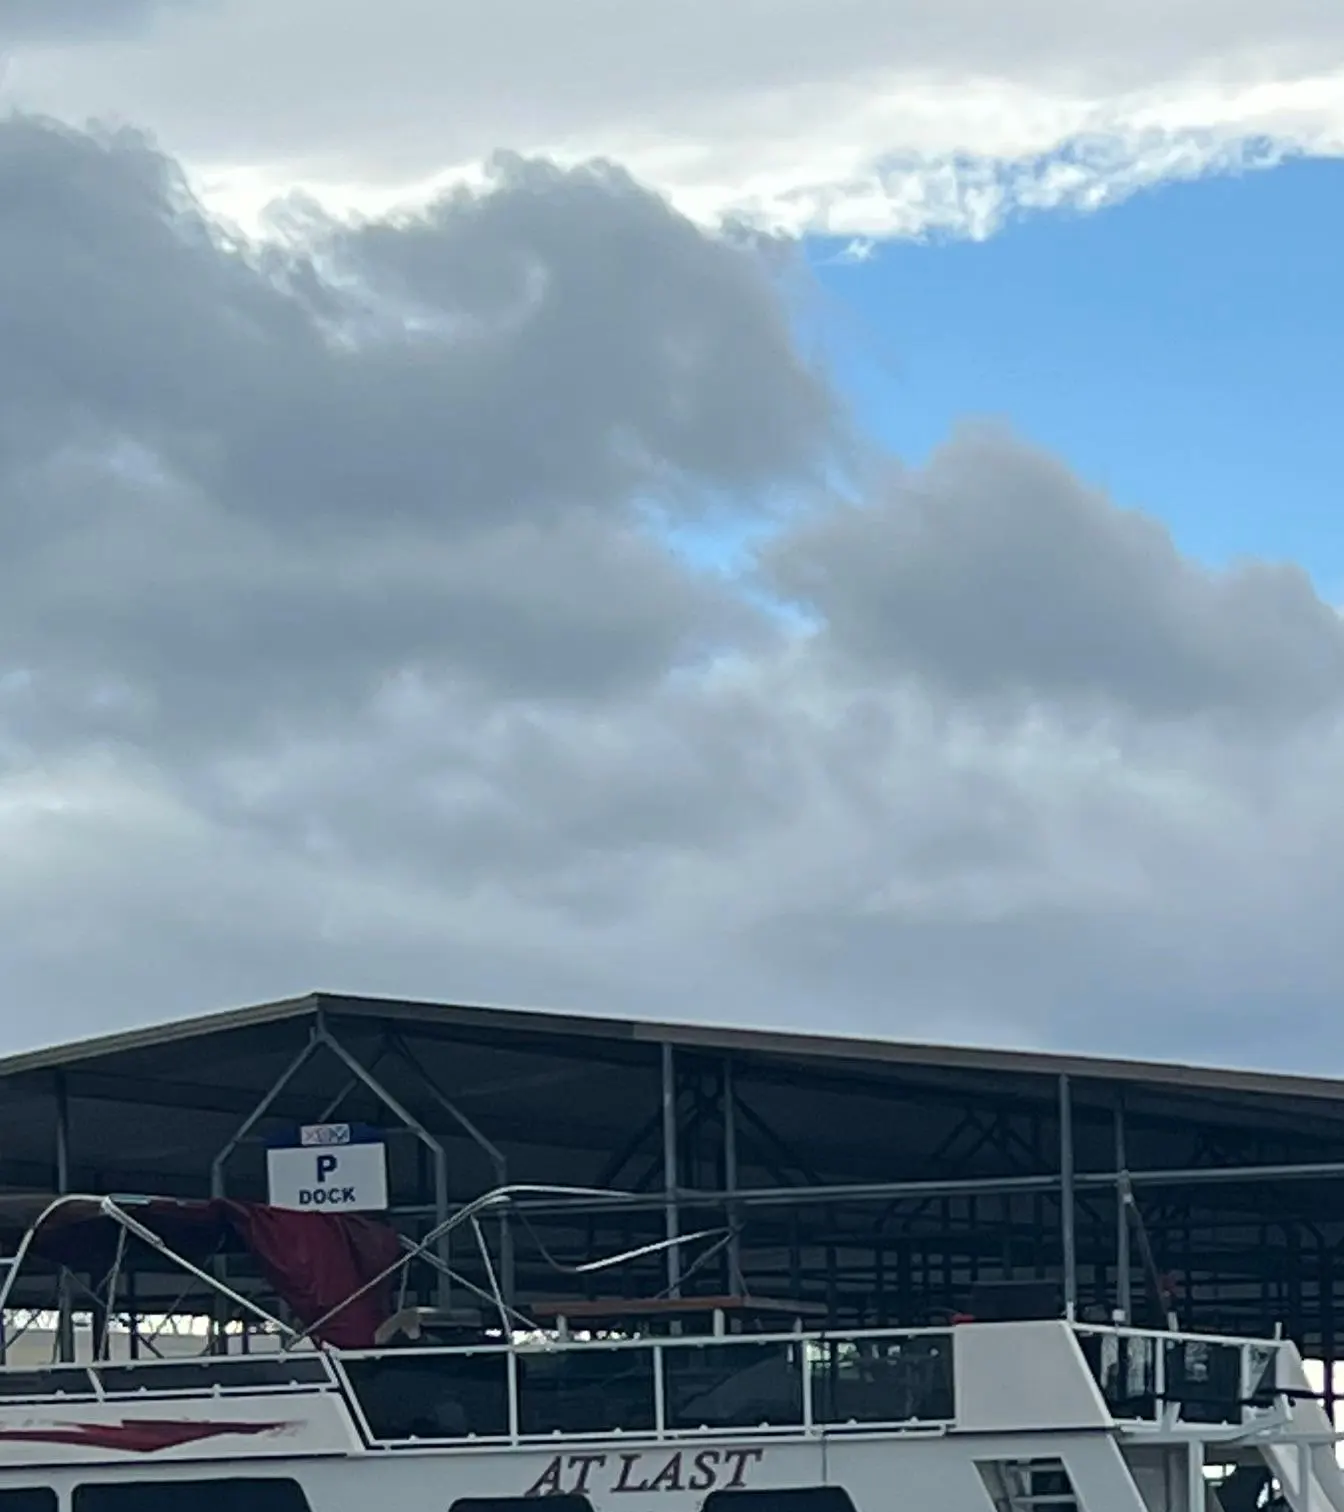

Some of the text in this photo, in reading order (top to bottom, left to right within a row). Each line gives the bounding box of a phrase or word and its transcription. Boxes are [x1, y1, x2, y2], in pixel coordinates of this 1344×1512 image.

[317, 1155, 338, 1183] P
[299, 1187, 356, 1205] DOCK
[524, 1449, 764, 1497] AT LAST
